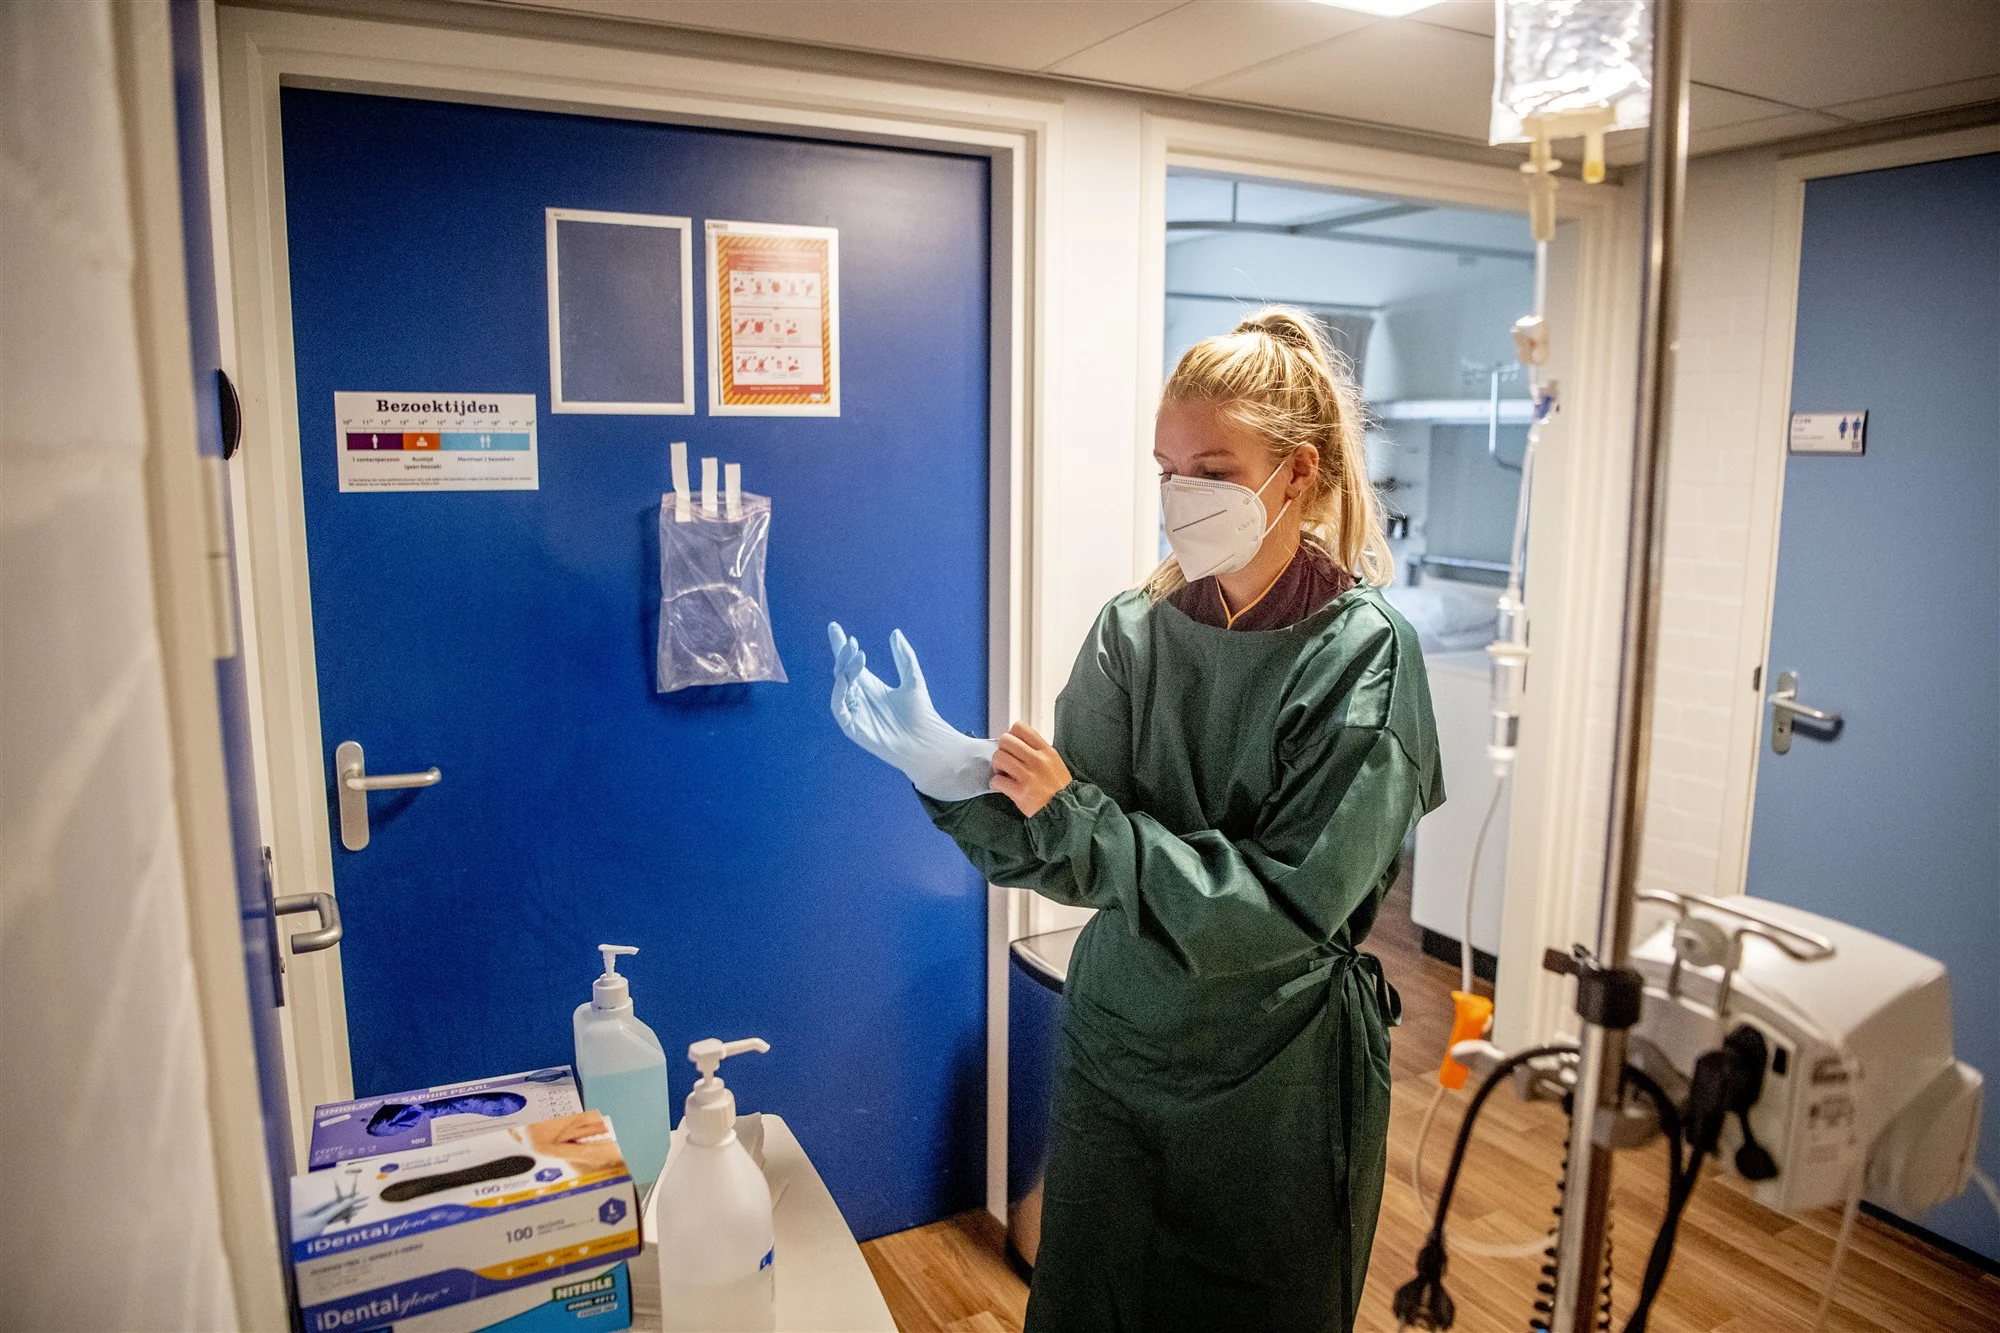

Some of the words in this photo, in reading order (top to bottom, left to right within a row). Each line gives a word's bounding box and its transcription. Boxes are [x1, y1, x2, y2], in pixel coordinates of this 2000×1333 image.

[377, 399, 499, 416] Bezoektijden
[401, 1090, 448, 1103] SAPHIR
[450, 1083, 491, 1096] PEARL
[474, 1186, 501, 1197] 100
[506, 1225, 533, 1244] 100
[556, 1276, 614, 1300] NITRILE
